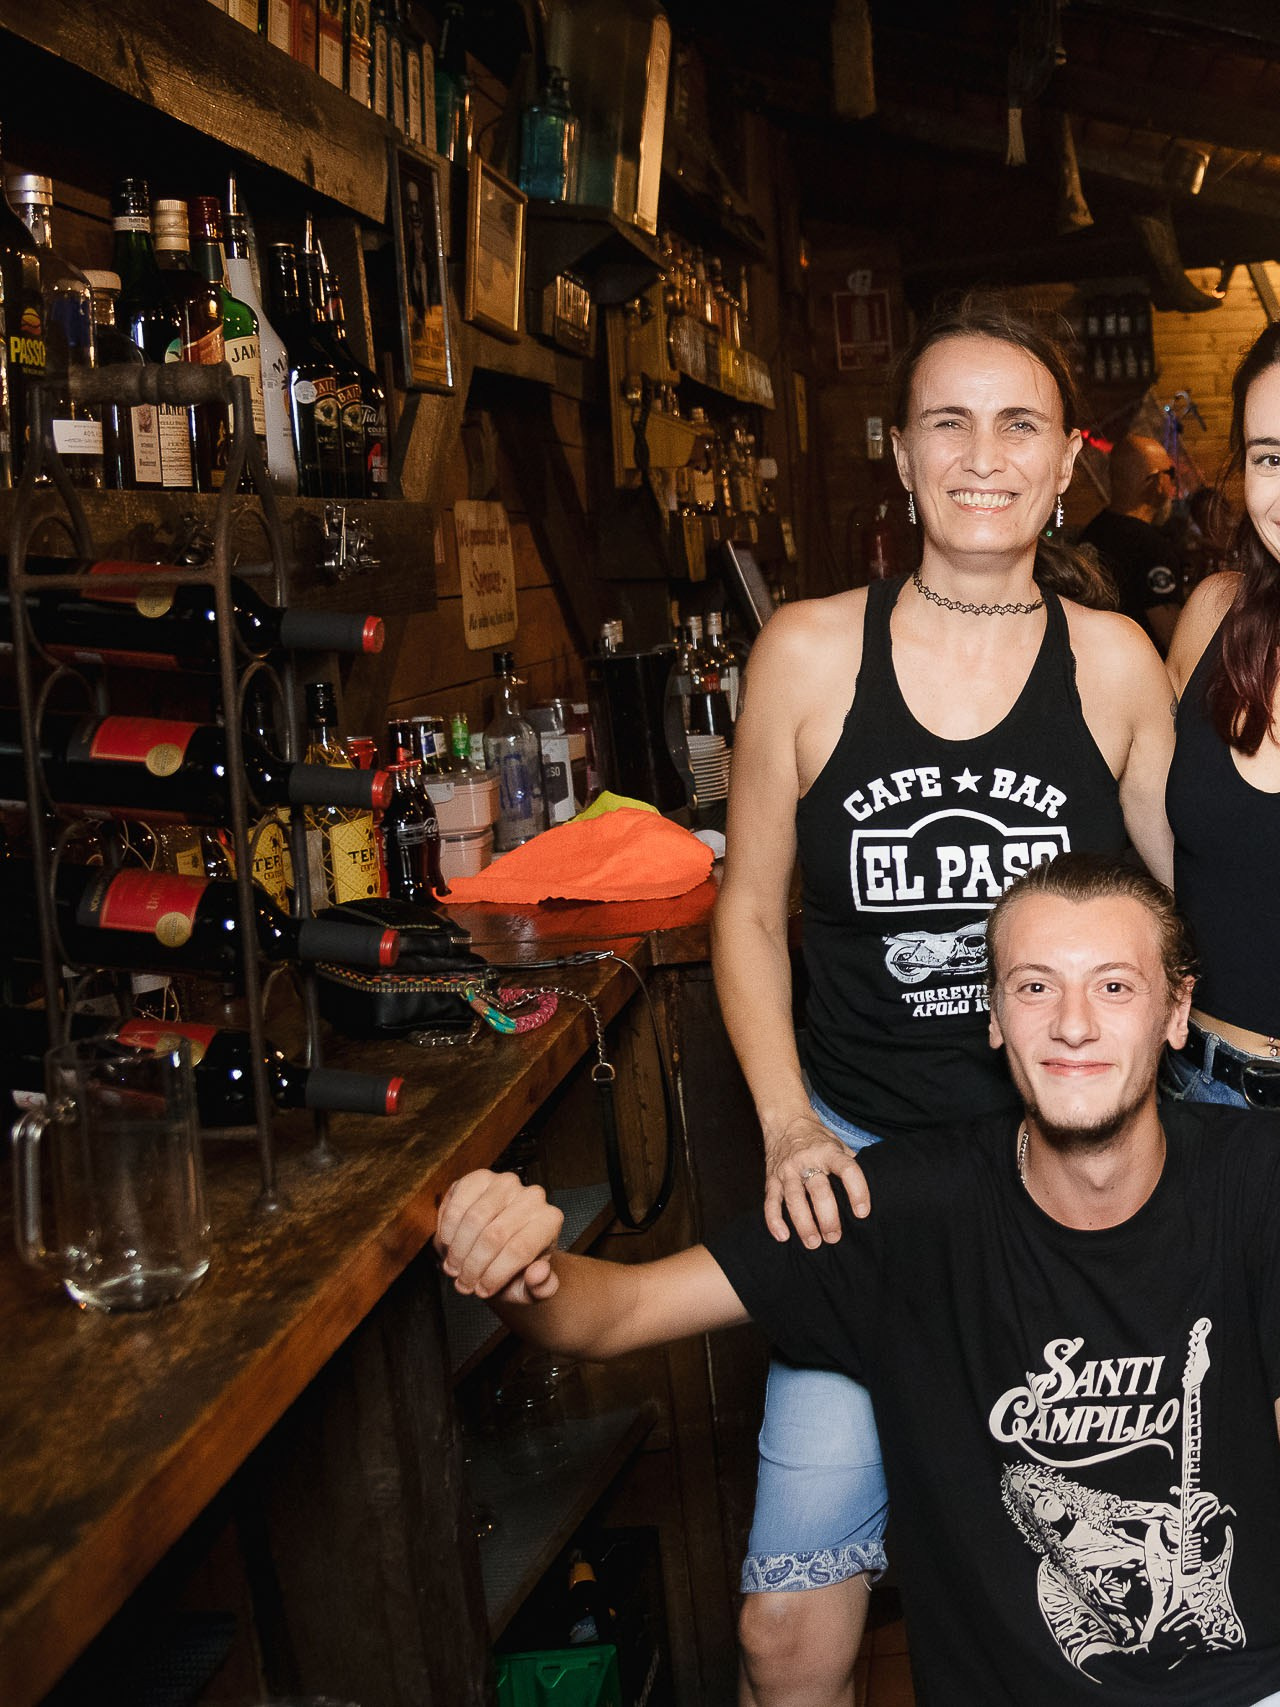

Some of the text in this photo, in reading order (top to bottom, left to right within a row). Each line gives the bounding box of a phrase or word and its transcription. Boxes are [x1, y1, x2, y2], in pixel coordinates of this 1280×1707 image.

[10, 336, 46, 367] PASSO
[843, 766, 1067, 821] CAFE BAR
[863, 846, 924, 900] EL
[912, 1000, 969, 1017] APOLO
[1030, 1337, 1166, 1404] SANTI
[989, 1384, 1179, 1446] CAMPILLO
